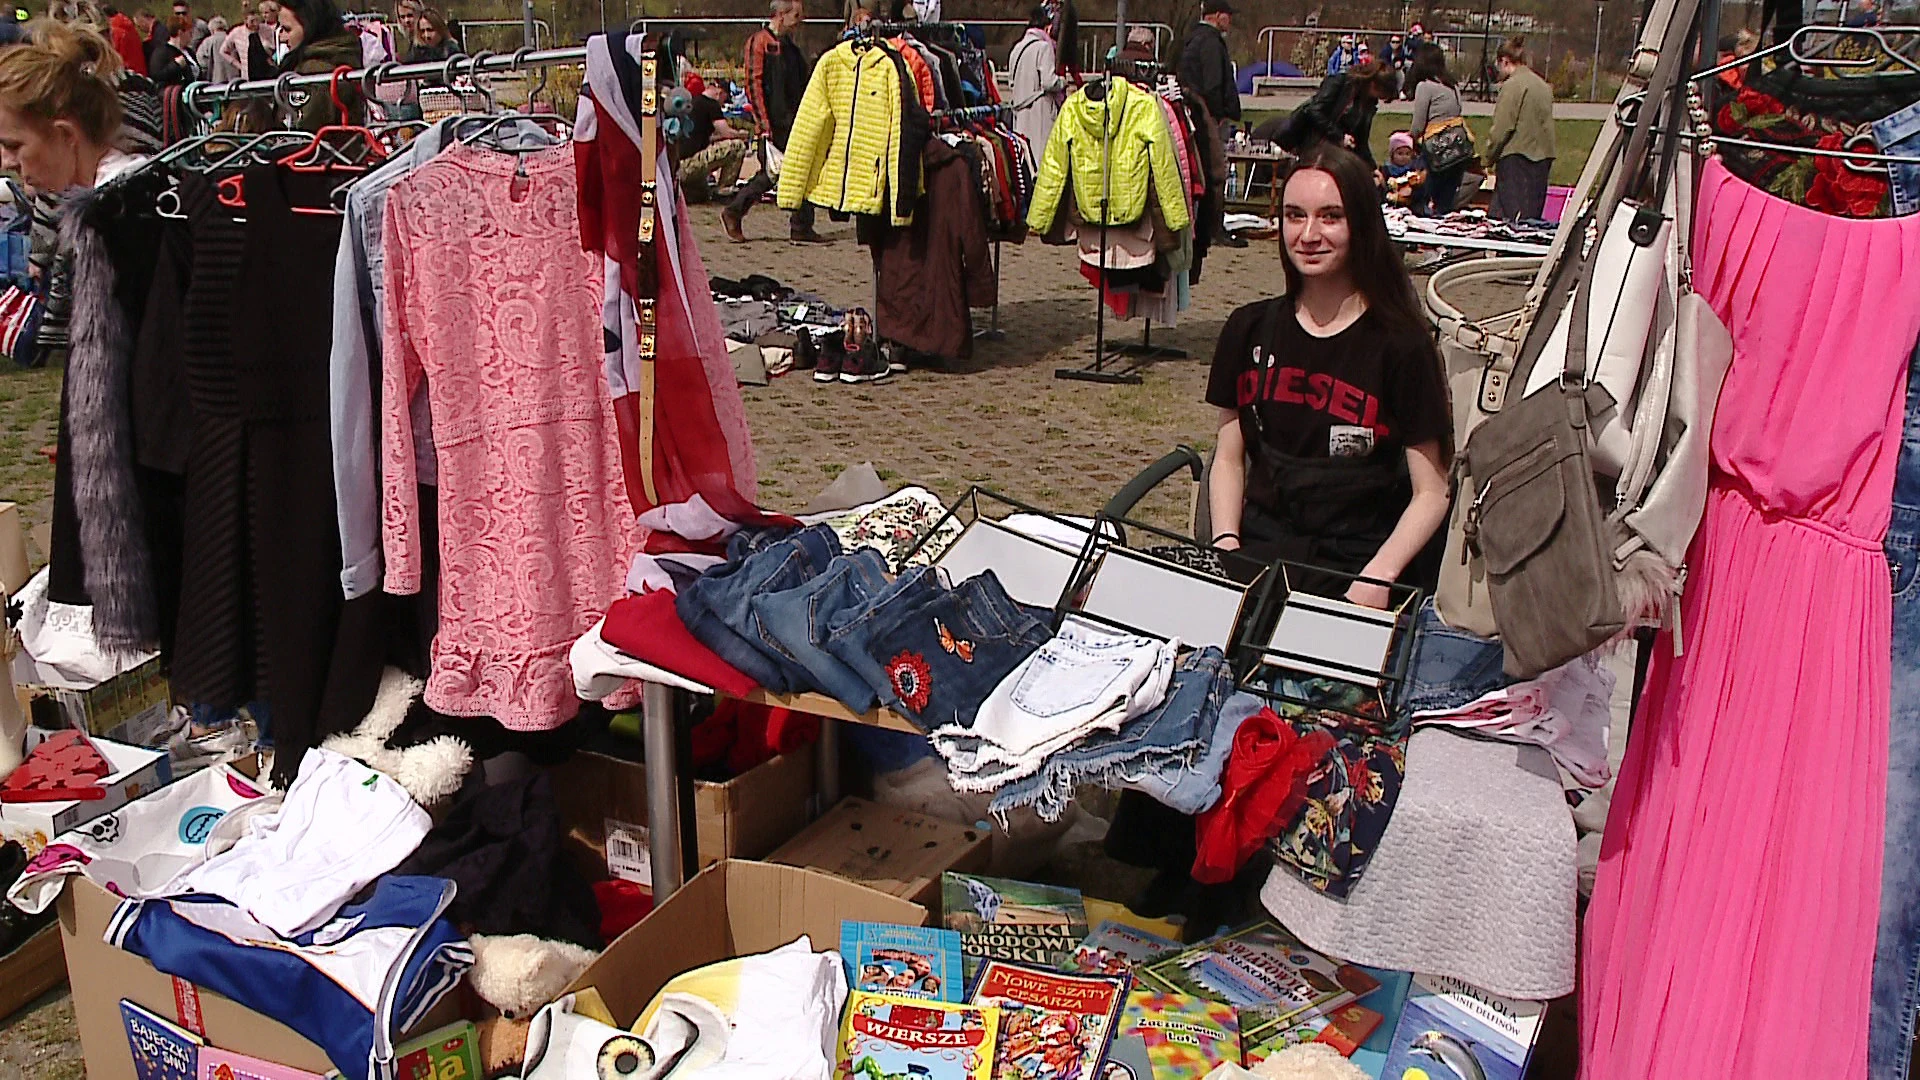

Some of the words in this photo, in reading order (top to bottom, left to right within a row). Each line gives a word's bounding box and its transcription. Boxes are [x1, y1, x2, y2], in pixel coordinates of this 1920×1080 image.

[1237, 367, 1389, 438] DIESEL
[988, 923, 1071, 937] PARKI
[992, 970, 1049, 993] NOWE
[1055, 984, 1111, 999] SZATY
[1006, 988, 1083, 1009] CESARZA
[1439, 985, 1474, 1010] KRAINIE
[130, 1018, 190, 1064] BAJECZKI
[866, 1021, 968, 1045] WIERSZE
[140, 1036, 159, 1057] DO
